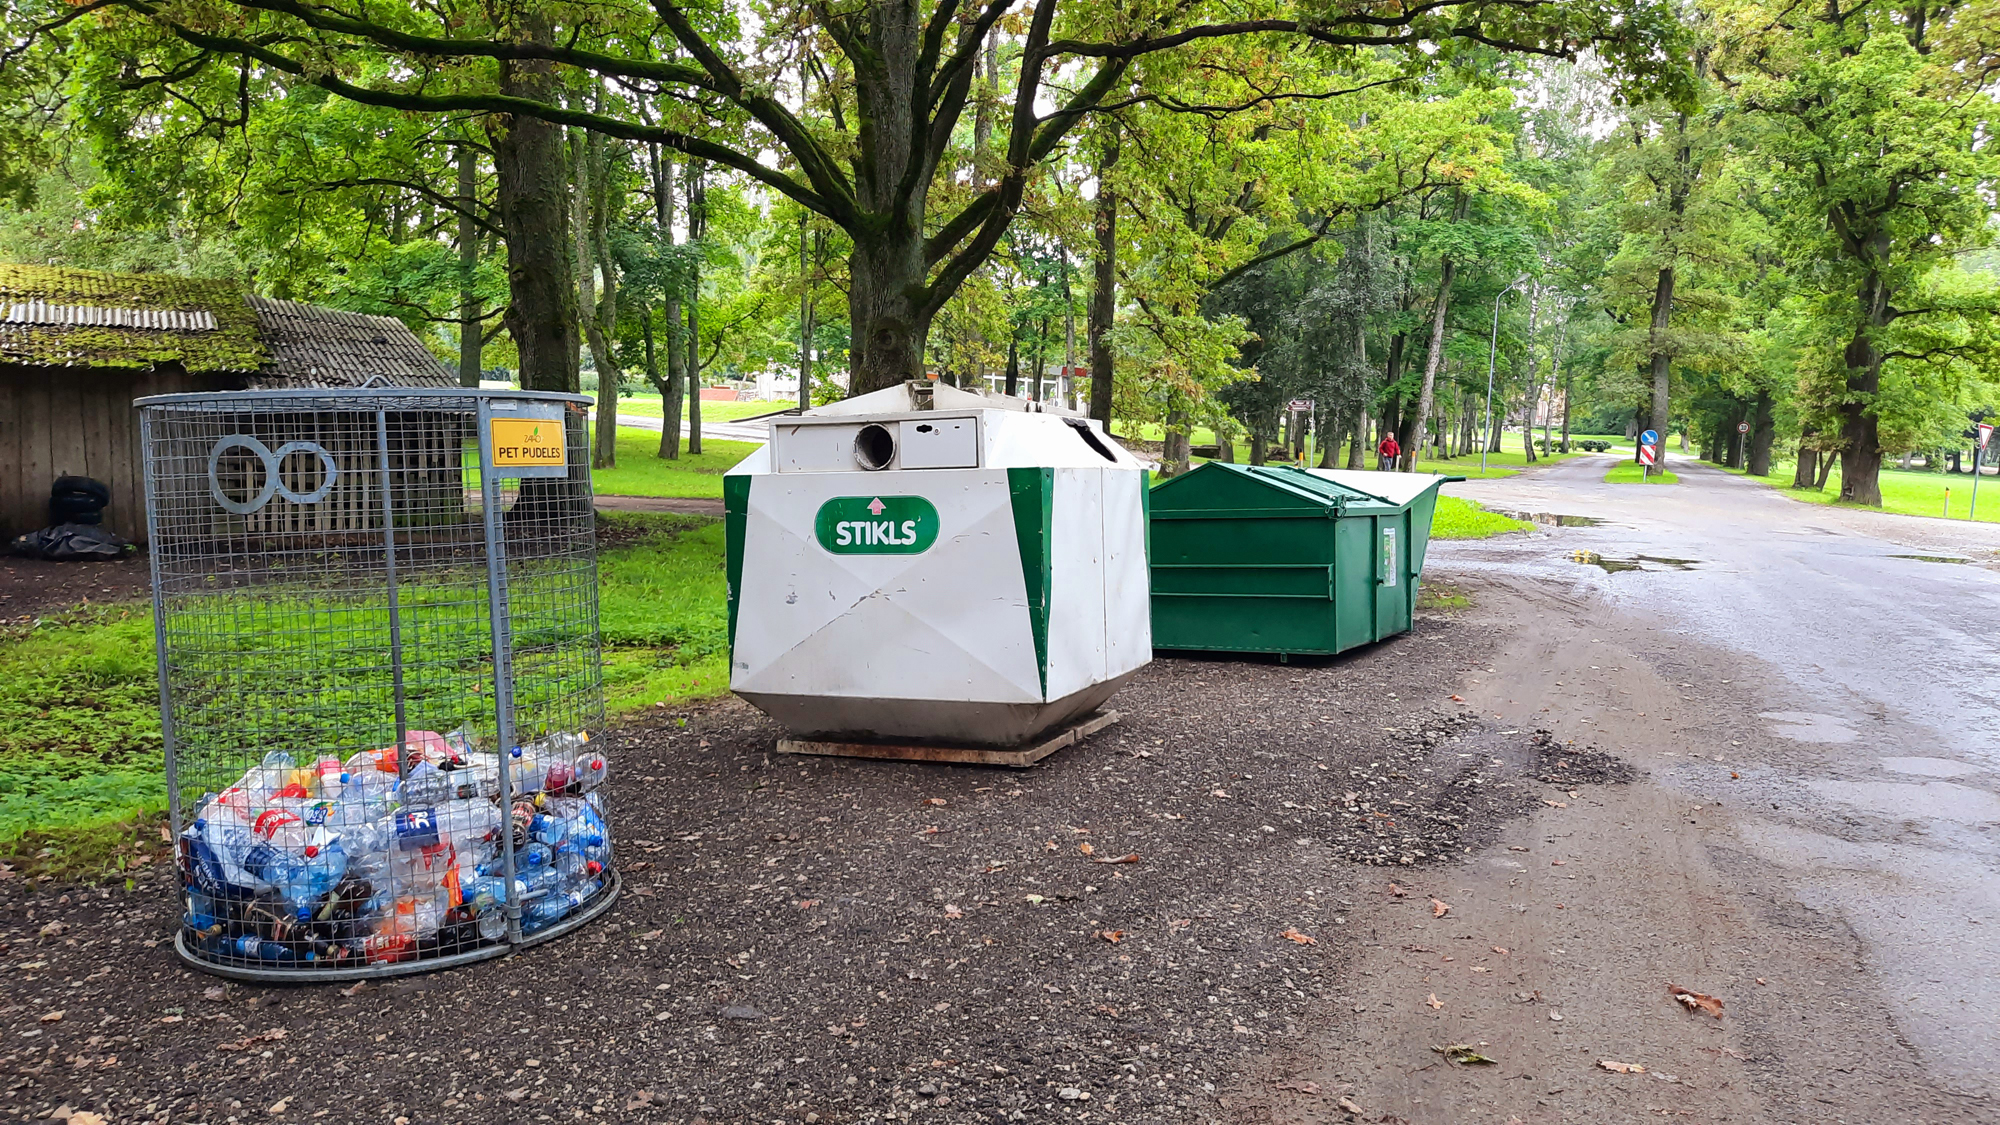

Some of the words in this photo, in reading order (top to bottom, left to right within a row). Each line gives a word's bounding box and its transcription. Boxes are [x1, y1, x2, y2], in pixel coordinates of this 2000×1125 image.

[499, 447, 519, 458] PET
[522, 447, 561, 458] PUDELES
[836, 520, 917, 546] STIKLS
